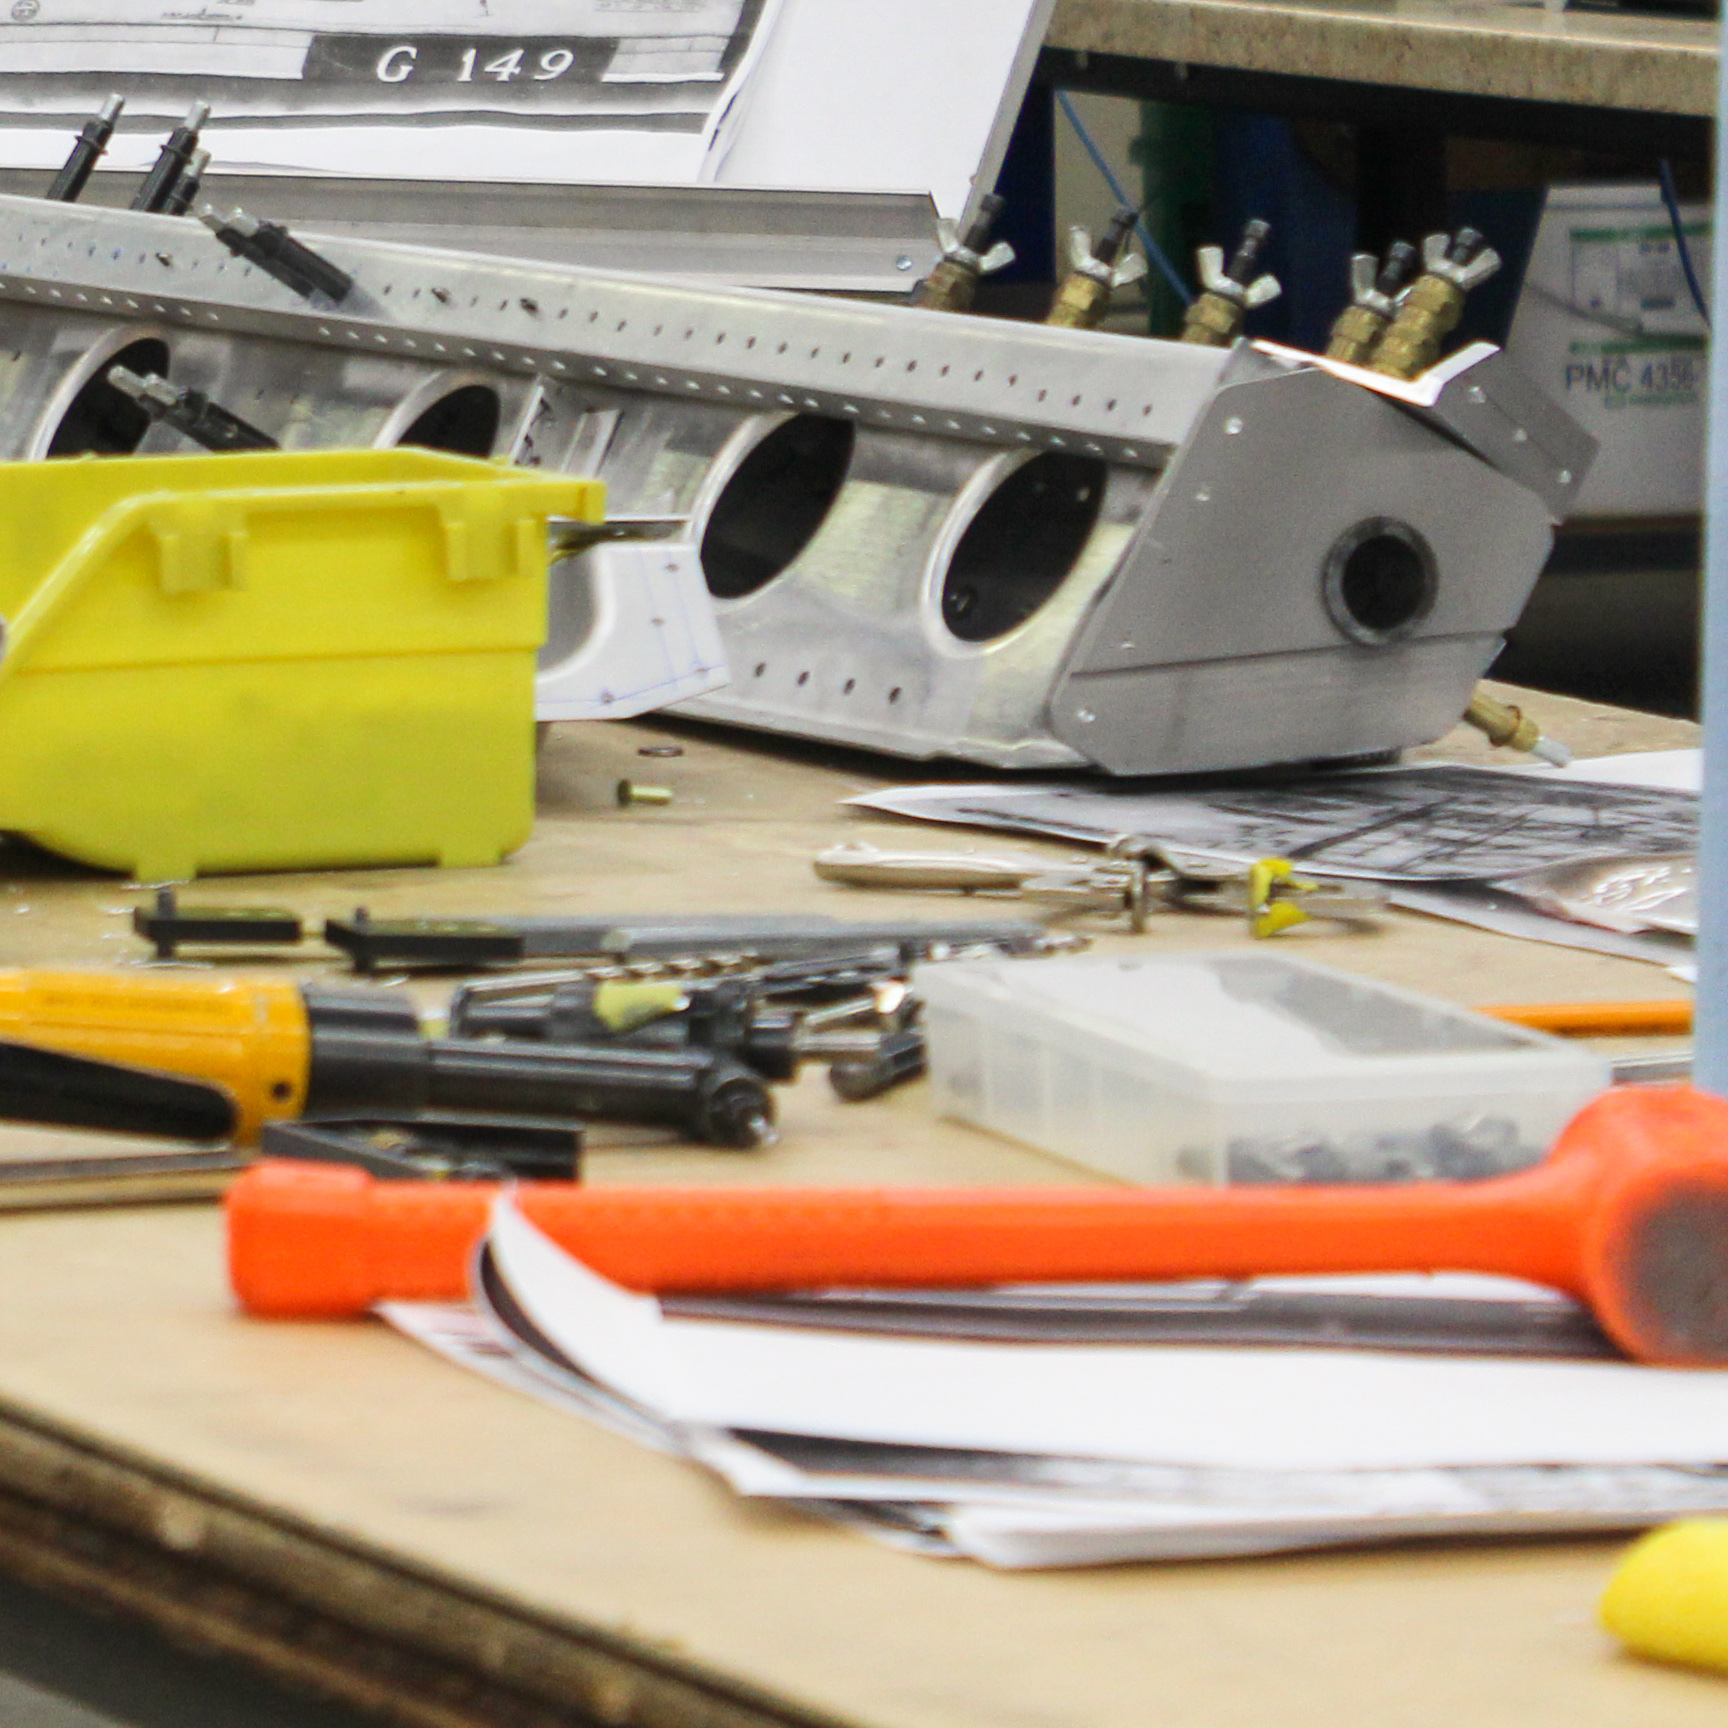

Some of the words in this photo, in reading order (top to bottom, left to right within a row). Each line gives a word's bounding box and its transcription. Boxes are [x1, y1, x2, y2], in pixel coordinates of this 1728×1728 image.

[375, 45, 418, 83] G
[456, 47, 575, 82] 149
[1565, 363, 1631, 394] PMC
